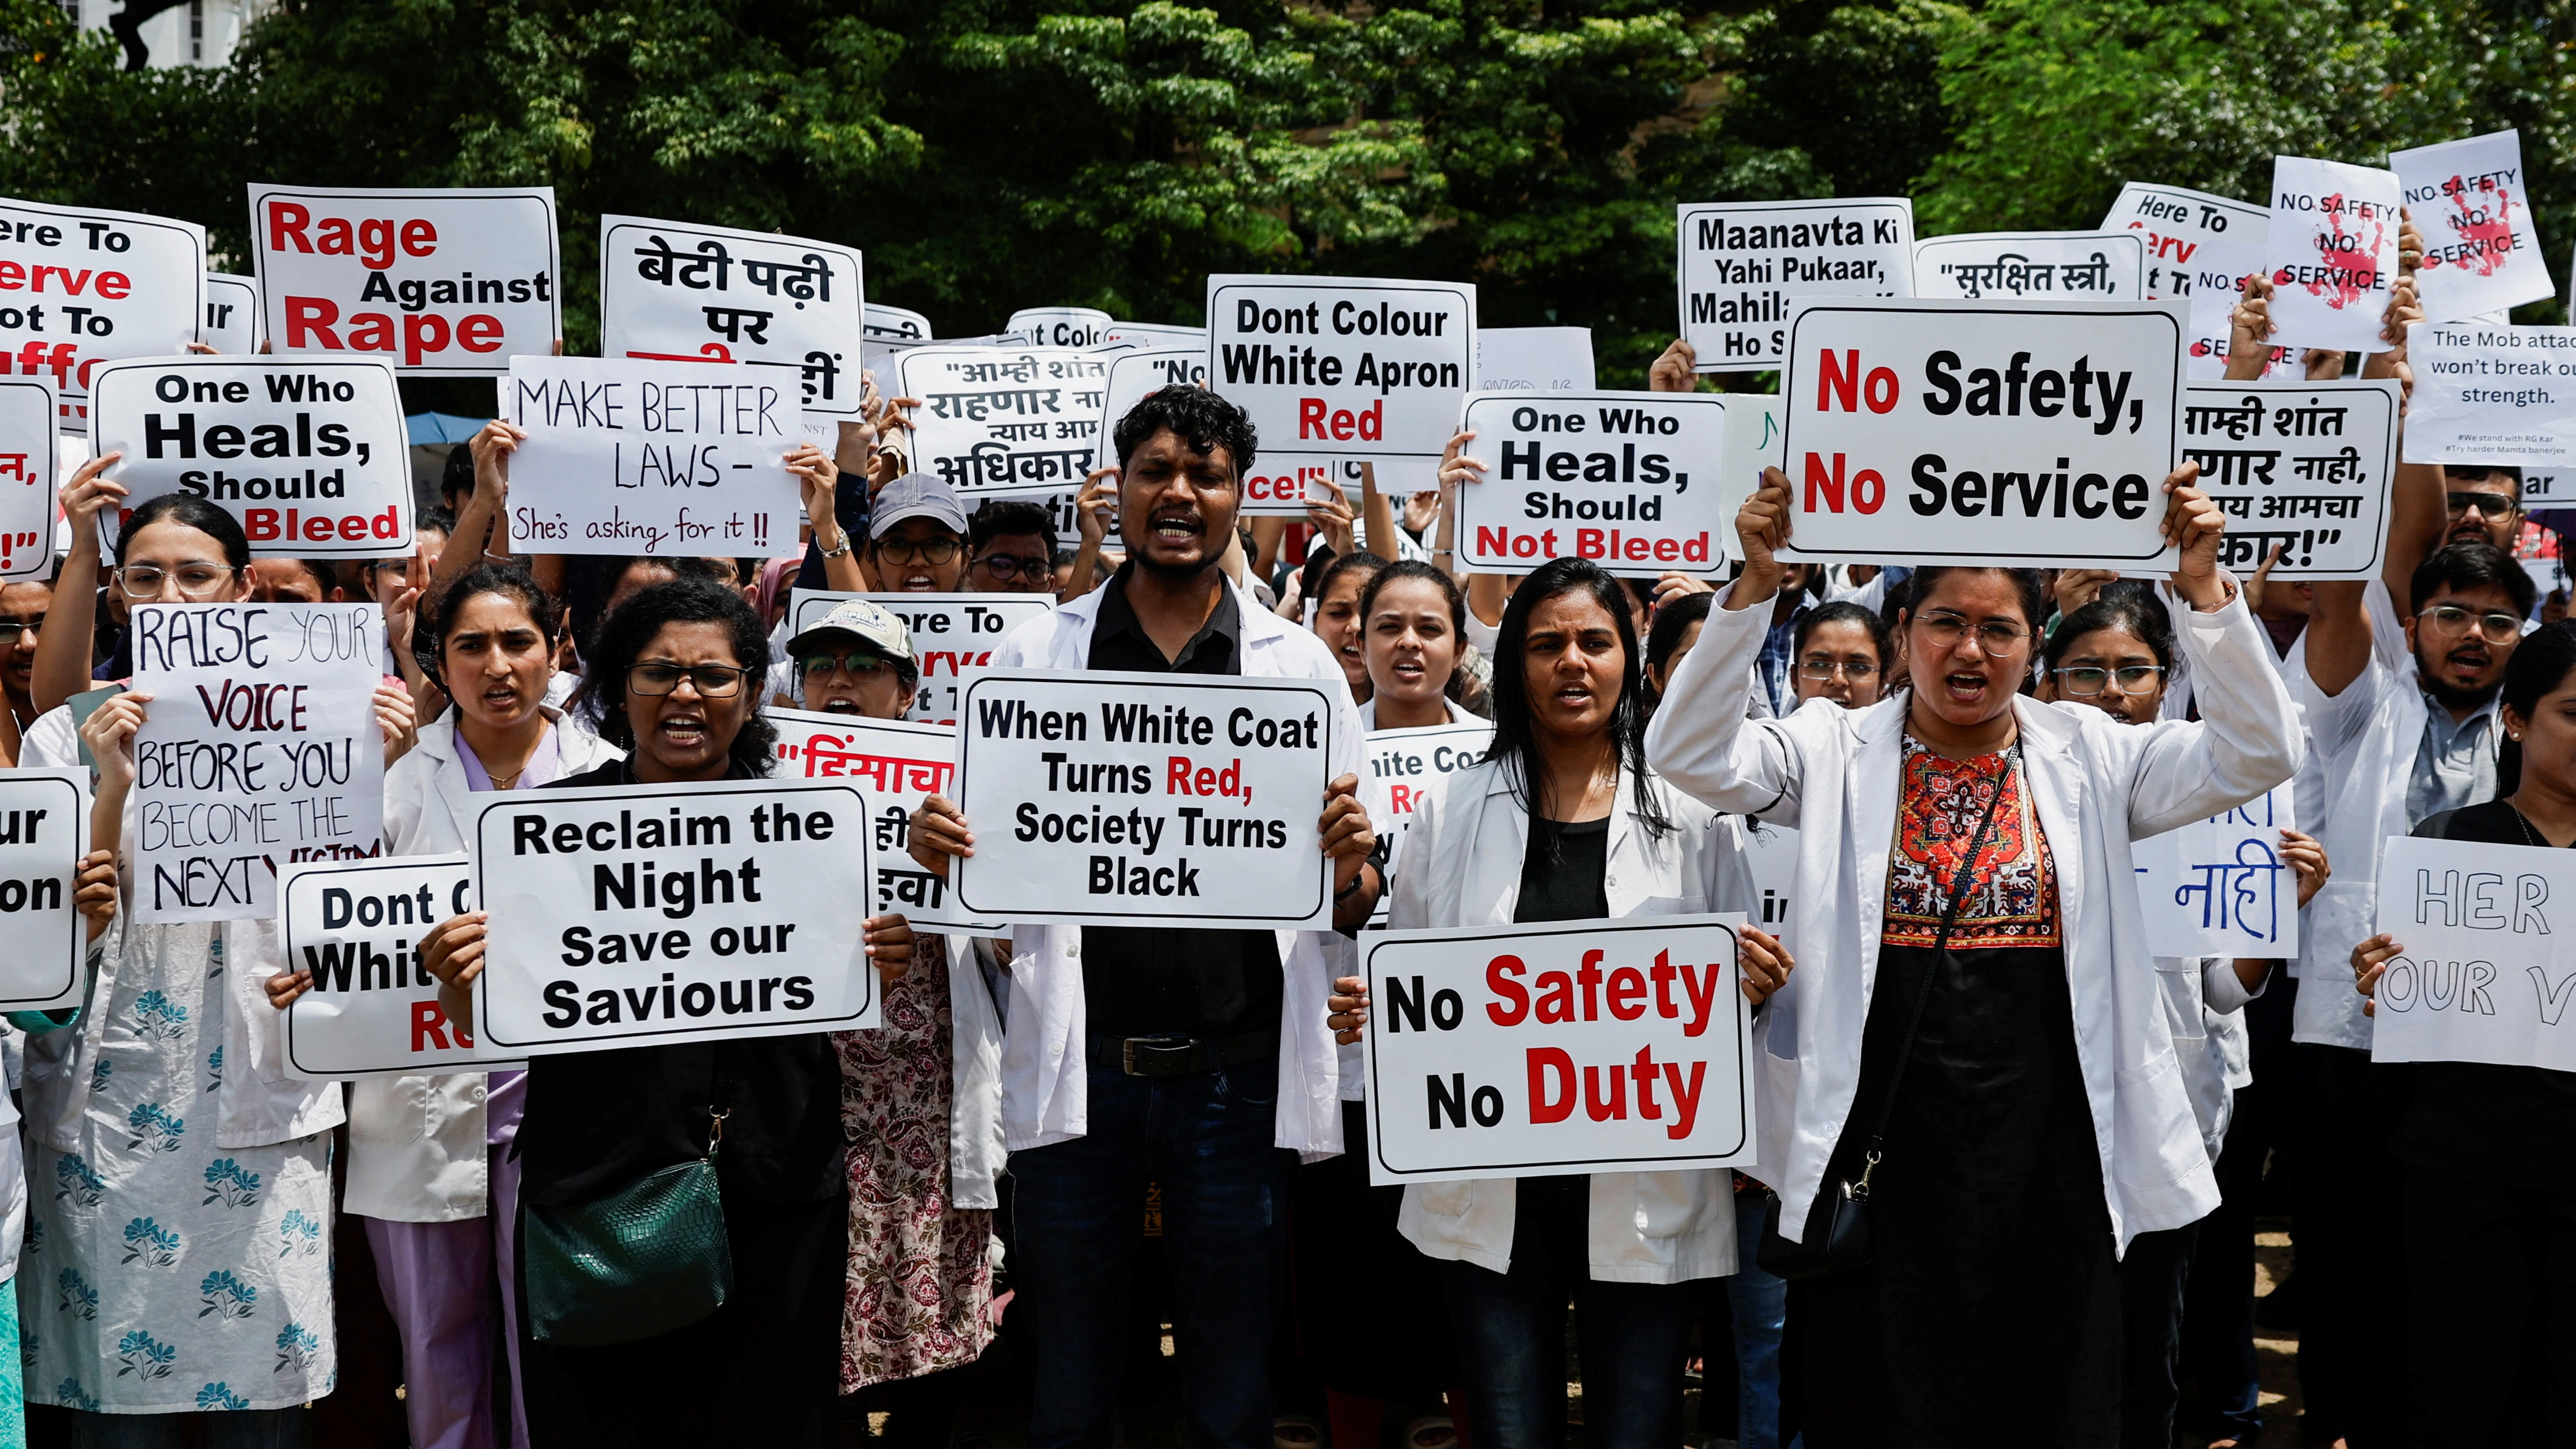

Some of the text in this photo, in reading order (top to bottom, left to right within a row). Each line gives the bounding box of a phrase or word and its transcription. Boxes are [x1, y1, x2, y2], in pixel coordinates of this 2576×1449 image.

[2281, 193, 2395, 221] NO SAFETY
[2405, 168, 2517, 204] NO SAFETY
[1698, 215, 1898, 251] Maanavta Ki
[2137, 195, 2228, 232] Here To
[2452, 210, 2484, 229] NO
[80, 222, 131, 253] To
[268, 201, 437, 270] Rage
[2318, 233, 2354, 253] NO
[2429, 233, 2524, 265] SERVICE
[0, 260, 131, 299] erve
[360, 270, 550, 312] Against
[634, 235, 834, 310] बेटी पढ़ी
[1715, 256, 1884, 284] Yahi Pukaar,
[2061, 252, 2116, 295] स्त्री,
[2199, 272, 2228, 289] NO
[2282, 265, 2385, 290] SERVICE
[0, 304, 113, 337] ot To
[702, 306, 774, 345] पर
[1237, 299, 1448, 336] Dont Colour
[1691, 290, 1790, 324] Mahil
[284, 296, 504, 366] Rape
[1725, 332, 1761, 356] Ho
[2434, 331, 2576, 348] The Mob attac
[946, 355, 1105, 383] "आम्ही शांत
[1221, 344, 1342, 386] White
[1354, 352, 1459, 396] Apron
[2432, 359, 2488, 374] won’t
[2495, 359, 2553, 375] break
[155, 374, 355, 403] One Who
[518, 378, 783, 436] MAKE BETTER
[926, 388, 1061, 421] राहणार
[1817, 348, 2143, 436] No Safety,
[2462, 387, 2555, 407] strength.
[1299, 398, 1383, 441] Red
[1512, 407, 1680, 435] One Who
[2273, 397, 2348, 436] शांत
[144, 413, 370, 466] Heals,
[178, 469, 345, 501] Should
[615, 443, 720, 488] LAWS
[1501, 441, 1688, 494] Heals,
[1804, 452, 2149, 520] No Service
[2293, 446, 2366, 484] नाही,
[244, 505, 399, 541] Bleed
[1525, 492, 1662, 521] Should
[2259, 496, 2363, 519] आमचा
[512, 507, 568, 540] She's
[585, 505, 669, 553] asking
[674, 507, 715, 542] for
[725, 512, 744, 539] it
[1476, 526, 1709, 562] Not Bleed
[139, 607, 374, 672] RAISE YOUR
[964, 607, 1004, 633] To
[196, 679, 308, 732] VOICE
[978, 699, 1087, 741] When
[1101, 703, 1214, 745] White
[1228, 707, 1318, 749] Coat
[138, 738, 352, 794] BEFORE YOU
[1041, 752, 1253, 807] Turns Red,
[141, 797, 353, 851] BECOME THE
[513, 803, 834, 856] Reclaim the
[1014, 802, 1287, 856] Society Turns
[155, 856, 260, 910] NEXT
[593, 856, 761, 919] Night
[1088, 855, 1200, 897] Black
[2175, 838, 2286, 944] नाही
[322, 883, 434, 929] Dont
[2416, 869, 2552, 935] HER
[303, 939, 432, 992] Whit
[562, 923, 796, 967] Save our
[542, 973, 814, 1029] Saviours
[1386, 947, 1720, 1038] No Safety
[2381, 956, 2496, 1015] OUR
[1426, 1043, 1708, 1140] No Duty
